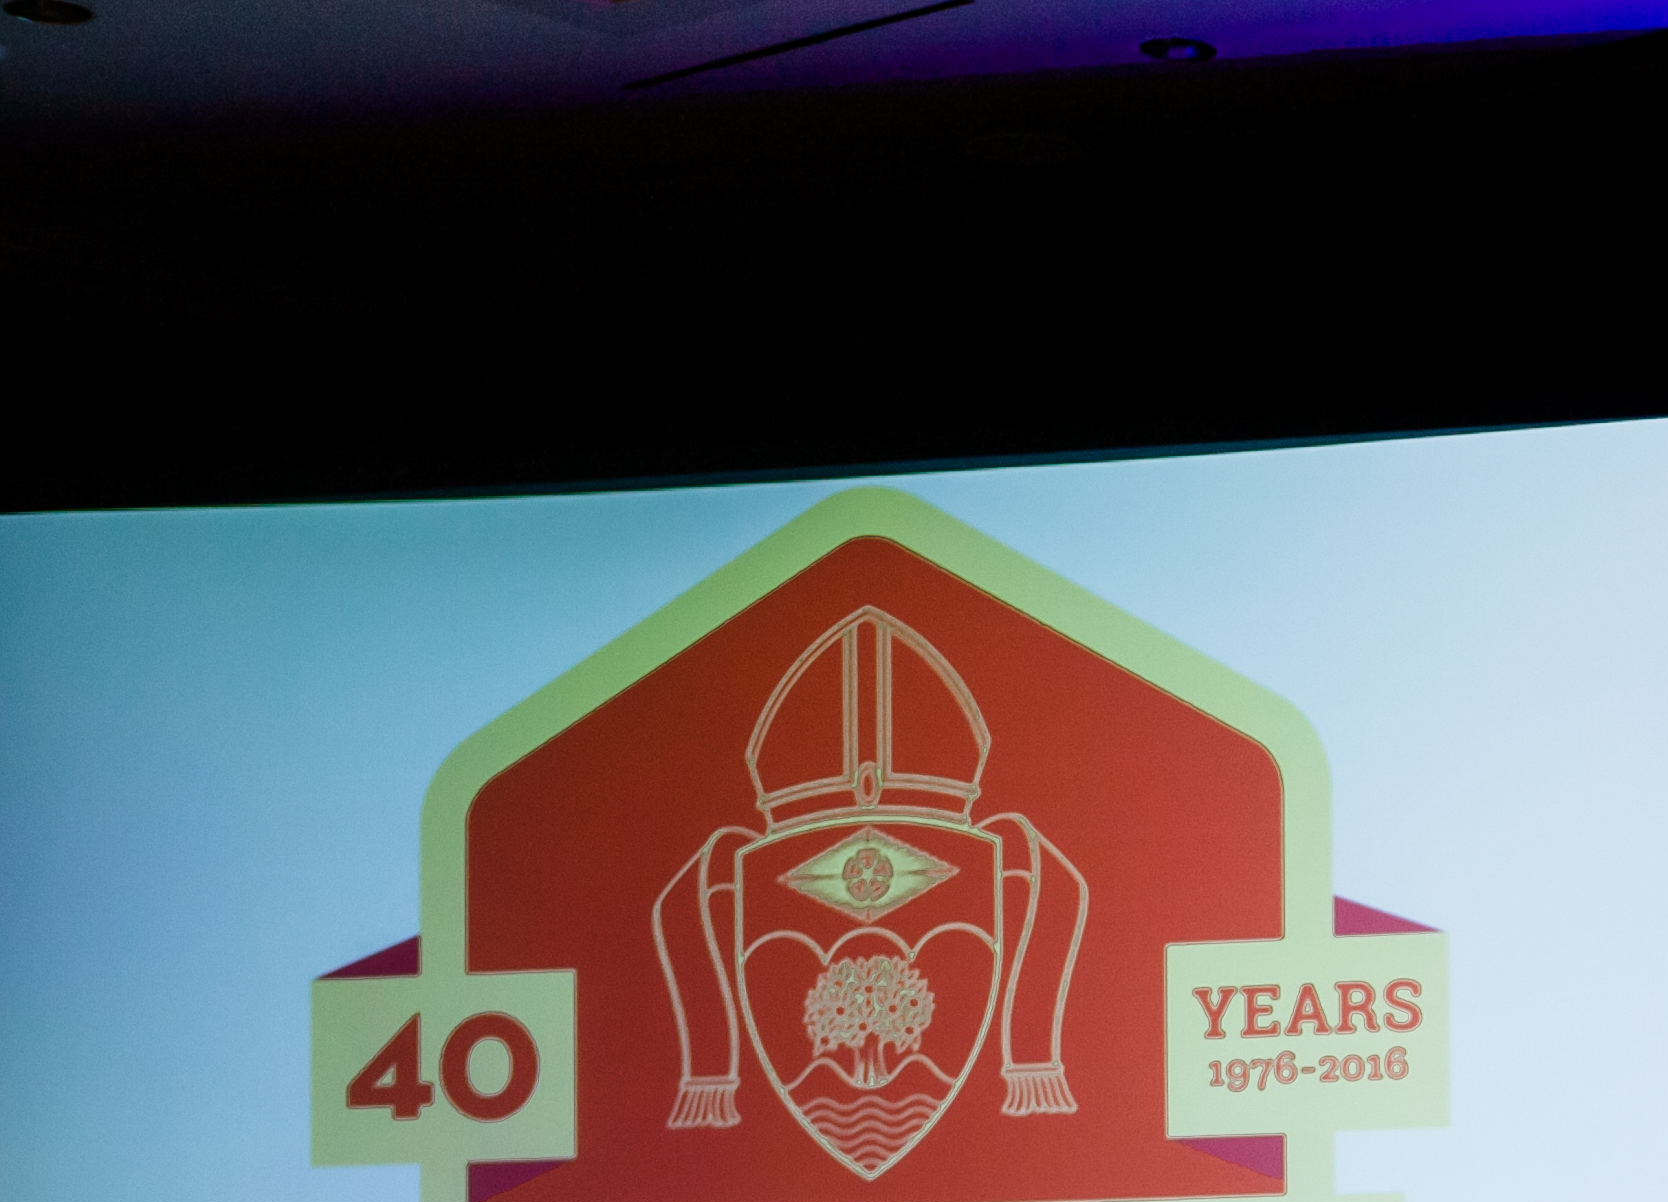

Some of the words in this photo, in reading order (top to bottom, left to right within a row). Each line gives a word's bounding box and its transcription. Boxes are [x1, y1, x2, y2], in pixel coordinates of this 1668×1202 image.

[1192, 978, 1423, 1039] YEARS
[346, 1011, 540, 1122] 40
[1208, 1046, 1409, 1092] 1976-2016
